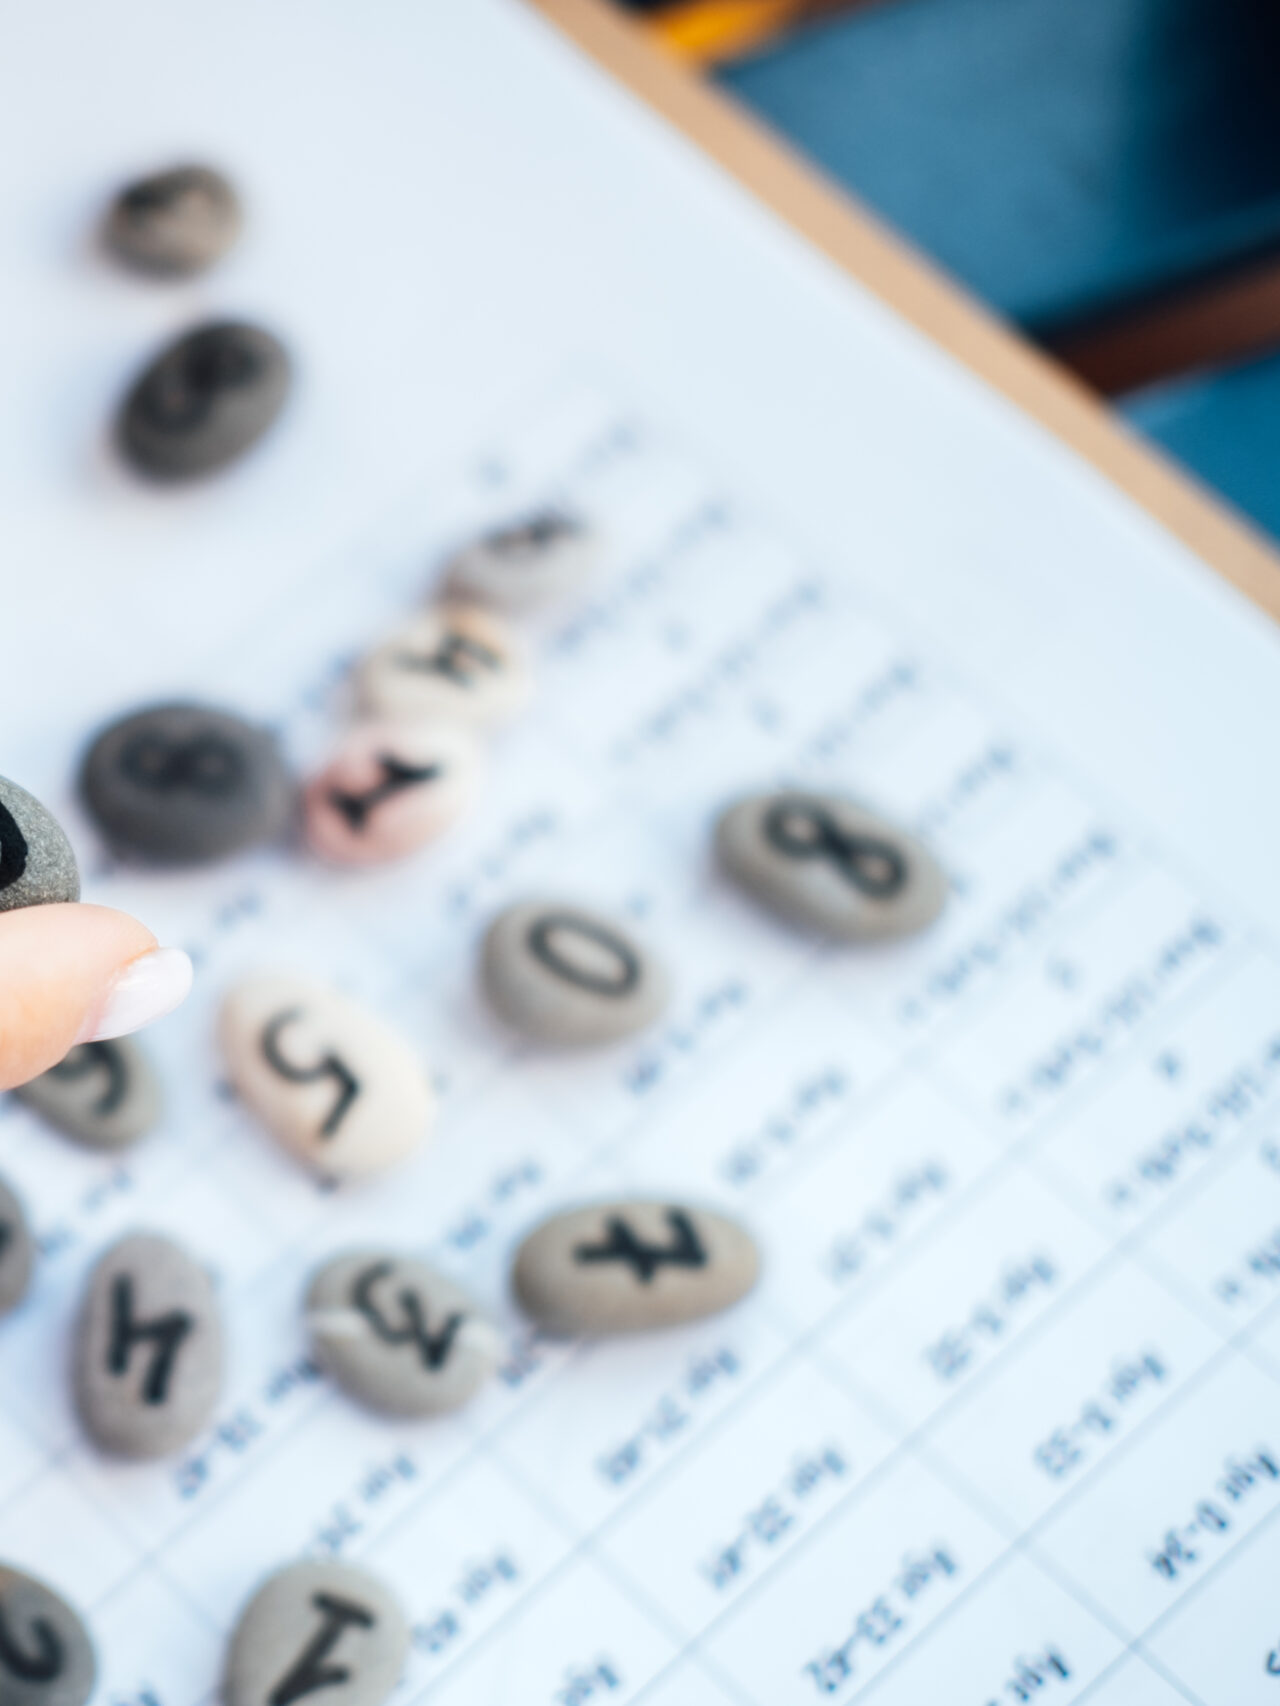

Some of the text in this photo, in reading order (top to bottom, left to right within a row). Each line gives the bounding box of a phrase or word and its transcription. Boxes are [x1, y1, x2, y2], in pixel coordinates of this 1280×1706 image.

[330, 748, 442, 832] 1
[765, 800, 910, 898] 8
[525, 912, 642, 998] 0
[260, 1005, 360, 1142] 5
[574, 1206, 709, 1286] 7
[108, 1272, 193, 1405] 4
[352, 1260, 464, 1372] 3
[268, 1588, 374, 1706] 1
